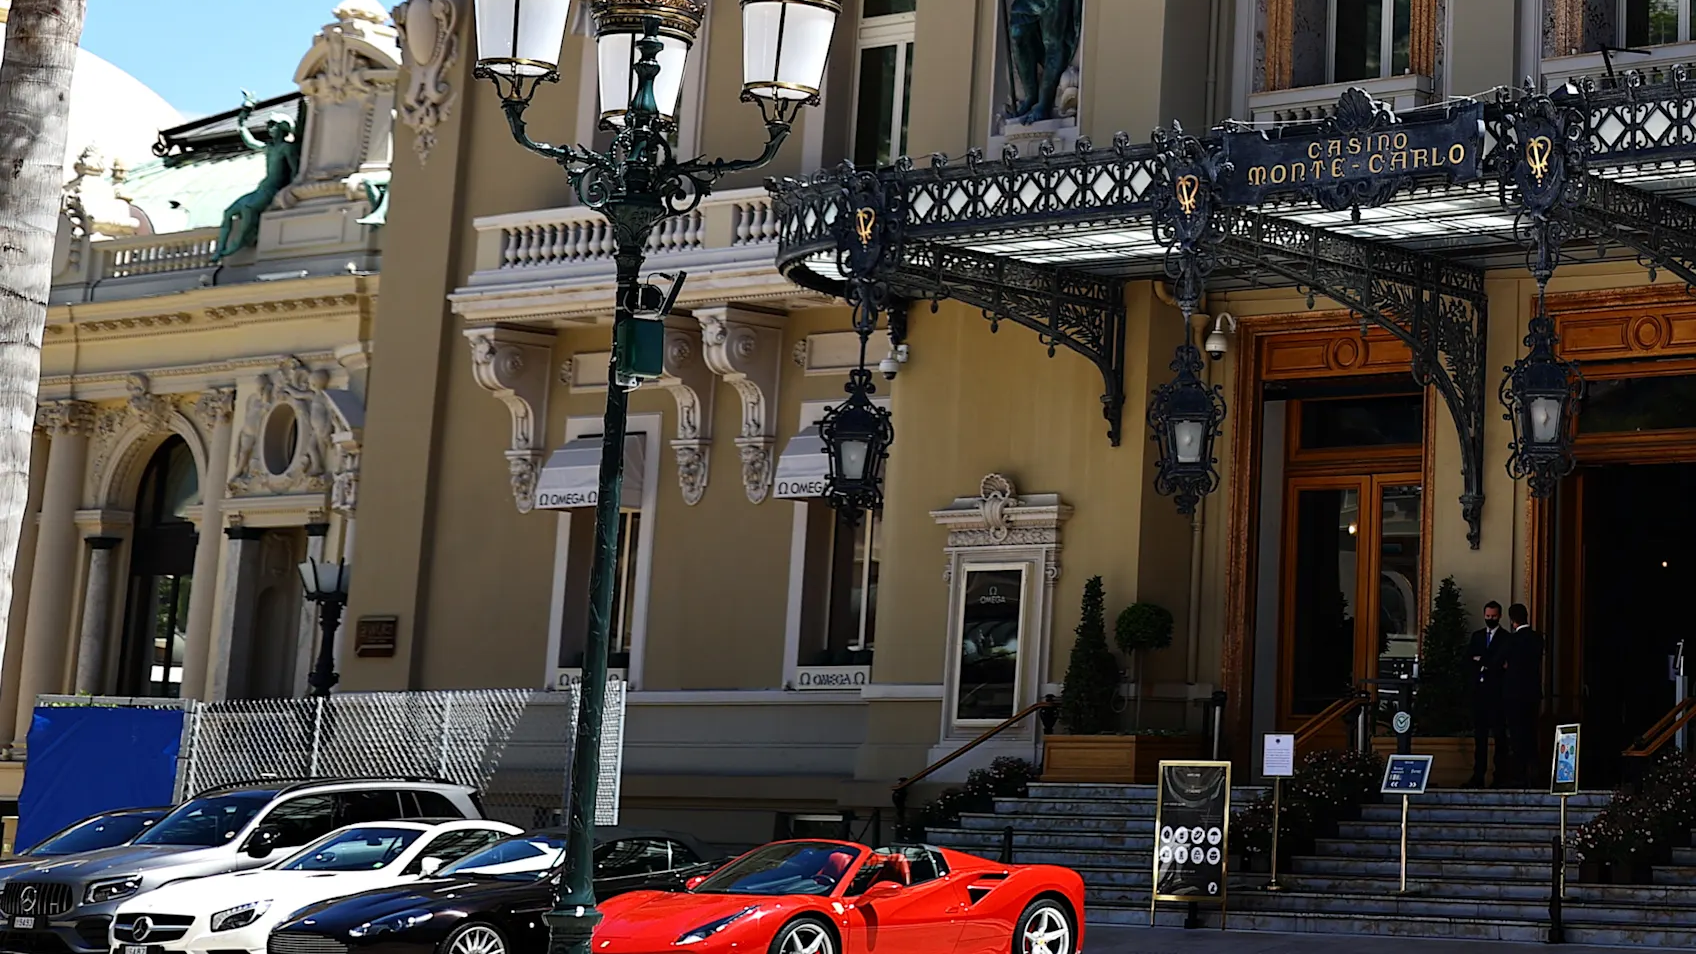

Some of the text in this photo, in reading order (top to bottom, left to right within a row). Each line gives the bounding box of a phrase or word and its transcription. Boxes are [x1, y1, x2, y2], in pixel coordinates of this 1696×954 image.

[1307, 132, 1408, 160] CASINO
[790, 481, 823, 494] OMEG
[550, 493, 585, 505] OMEGA
[979, 595, 1006, 604] OMEGA
[813, 673, 851, 686] OMEGA
